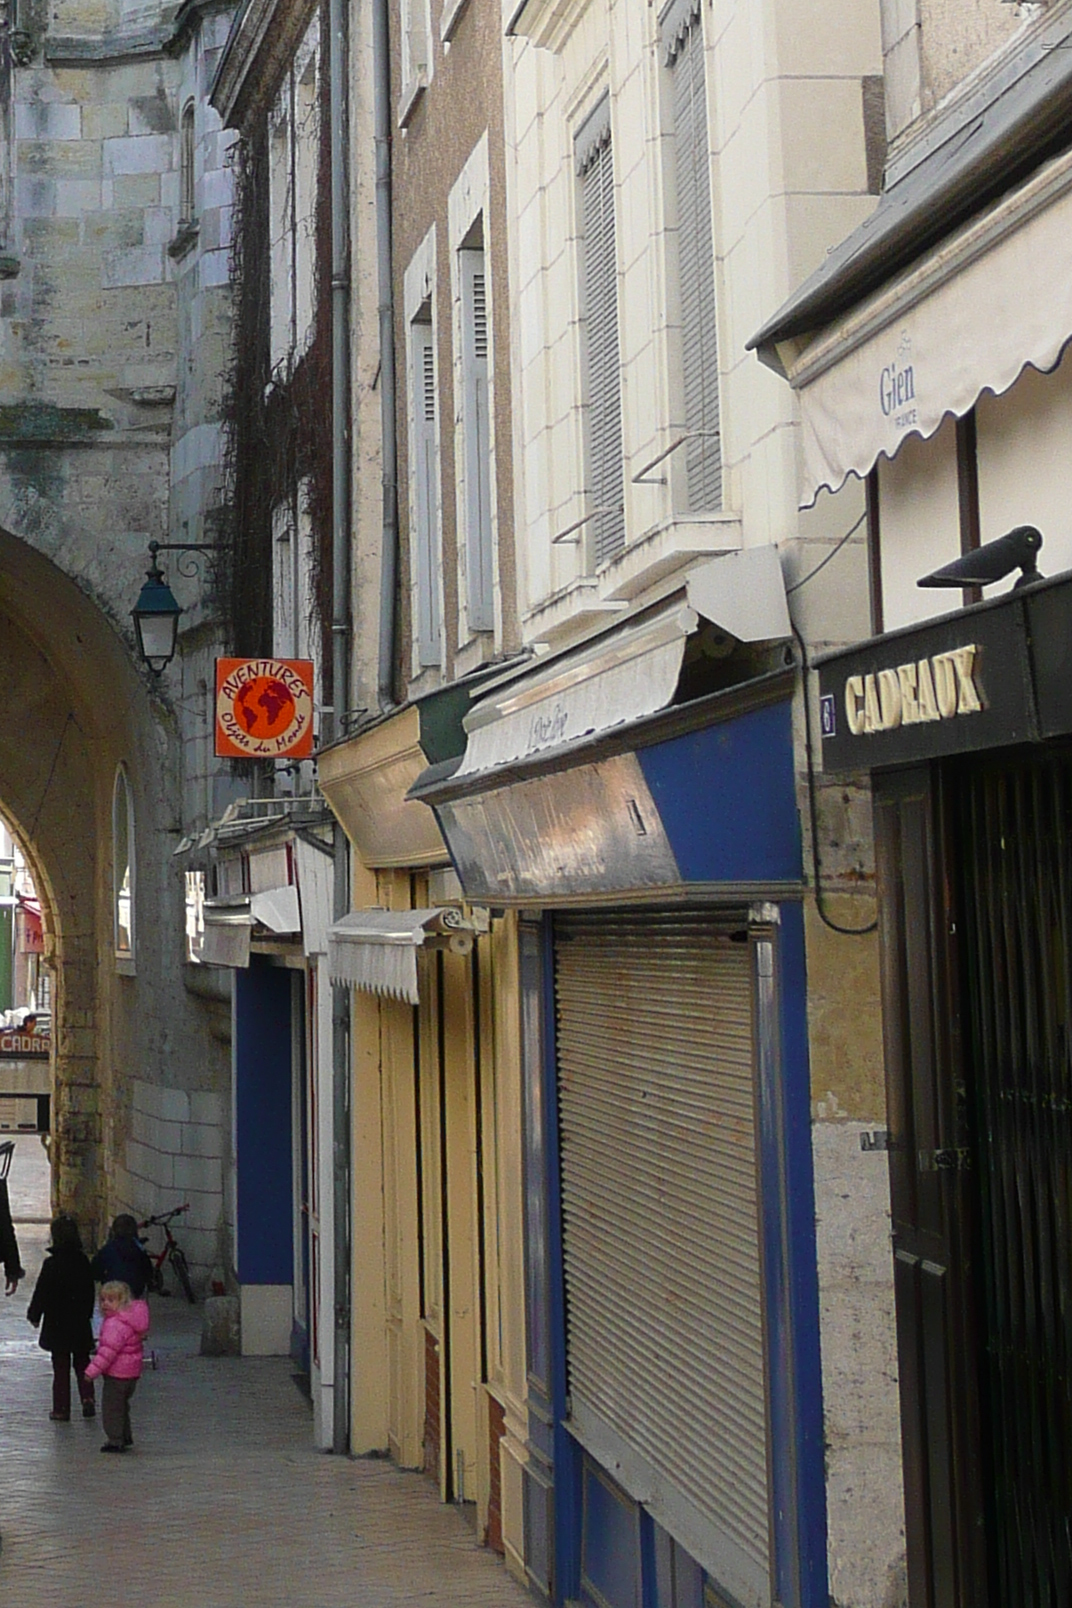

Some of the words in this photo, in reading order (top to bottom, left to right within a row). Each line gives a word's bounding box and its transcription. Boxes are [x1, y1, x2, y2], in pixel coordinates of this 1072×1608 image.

[880, 363, 915, 416] Gien
[222, 661, 311, 701] AVENTURES
[845, 643, 982, 736] CADEAUX
[254, 741, 270, 753] du
[276, 713, 306, 751] Monde
[823, 700, 830, 732] 6
